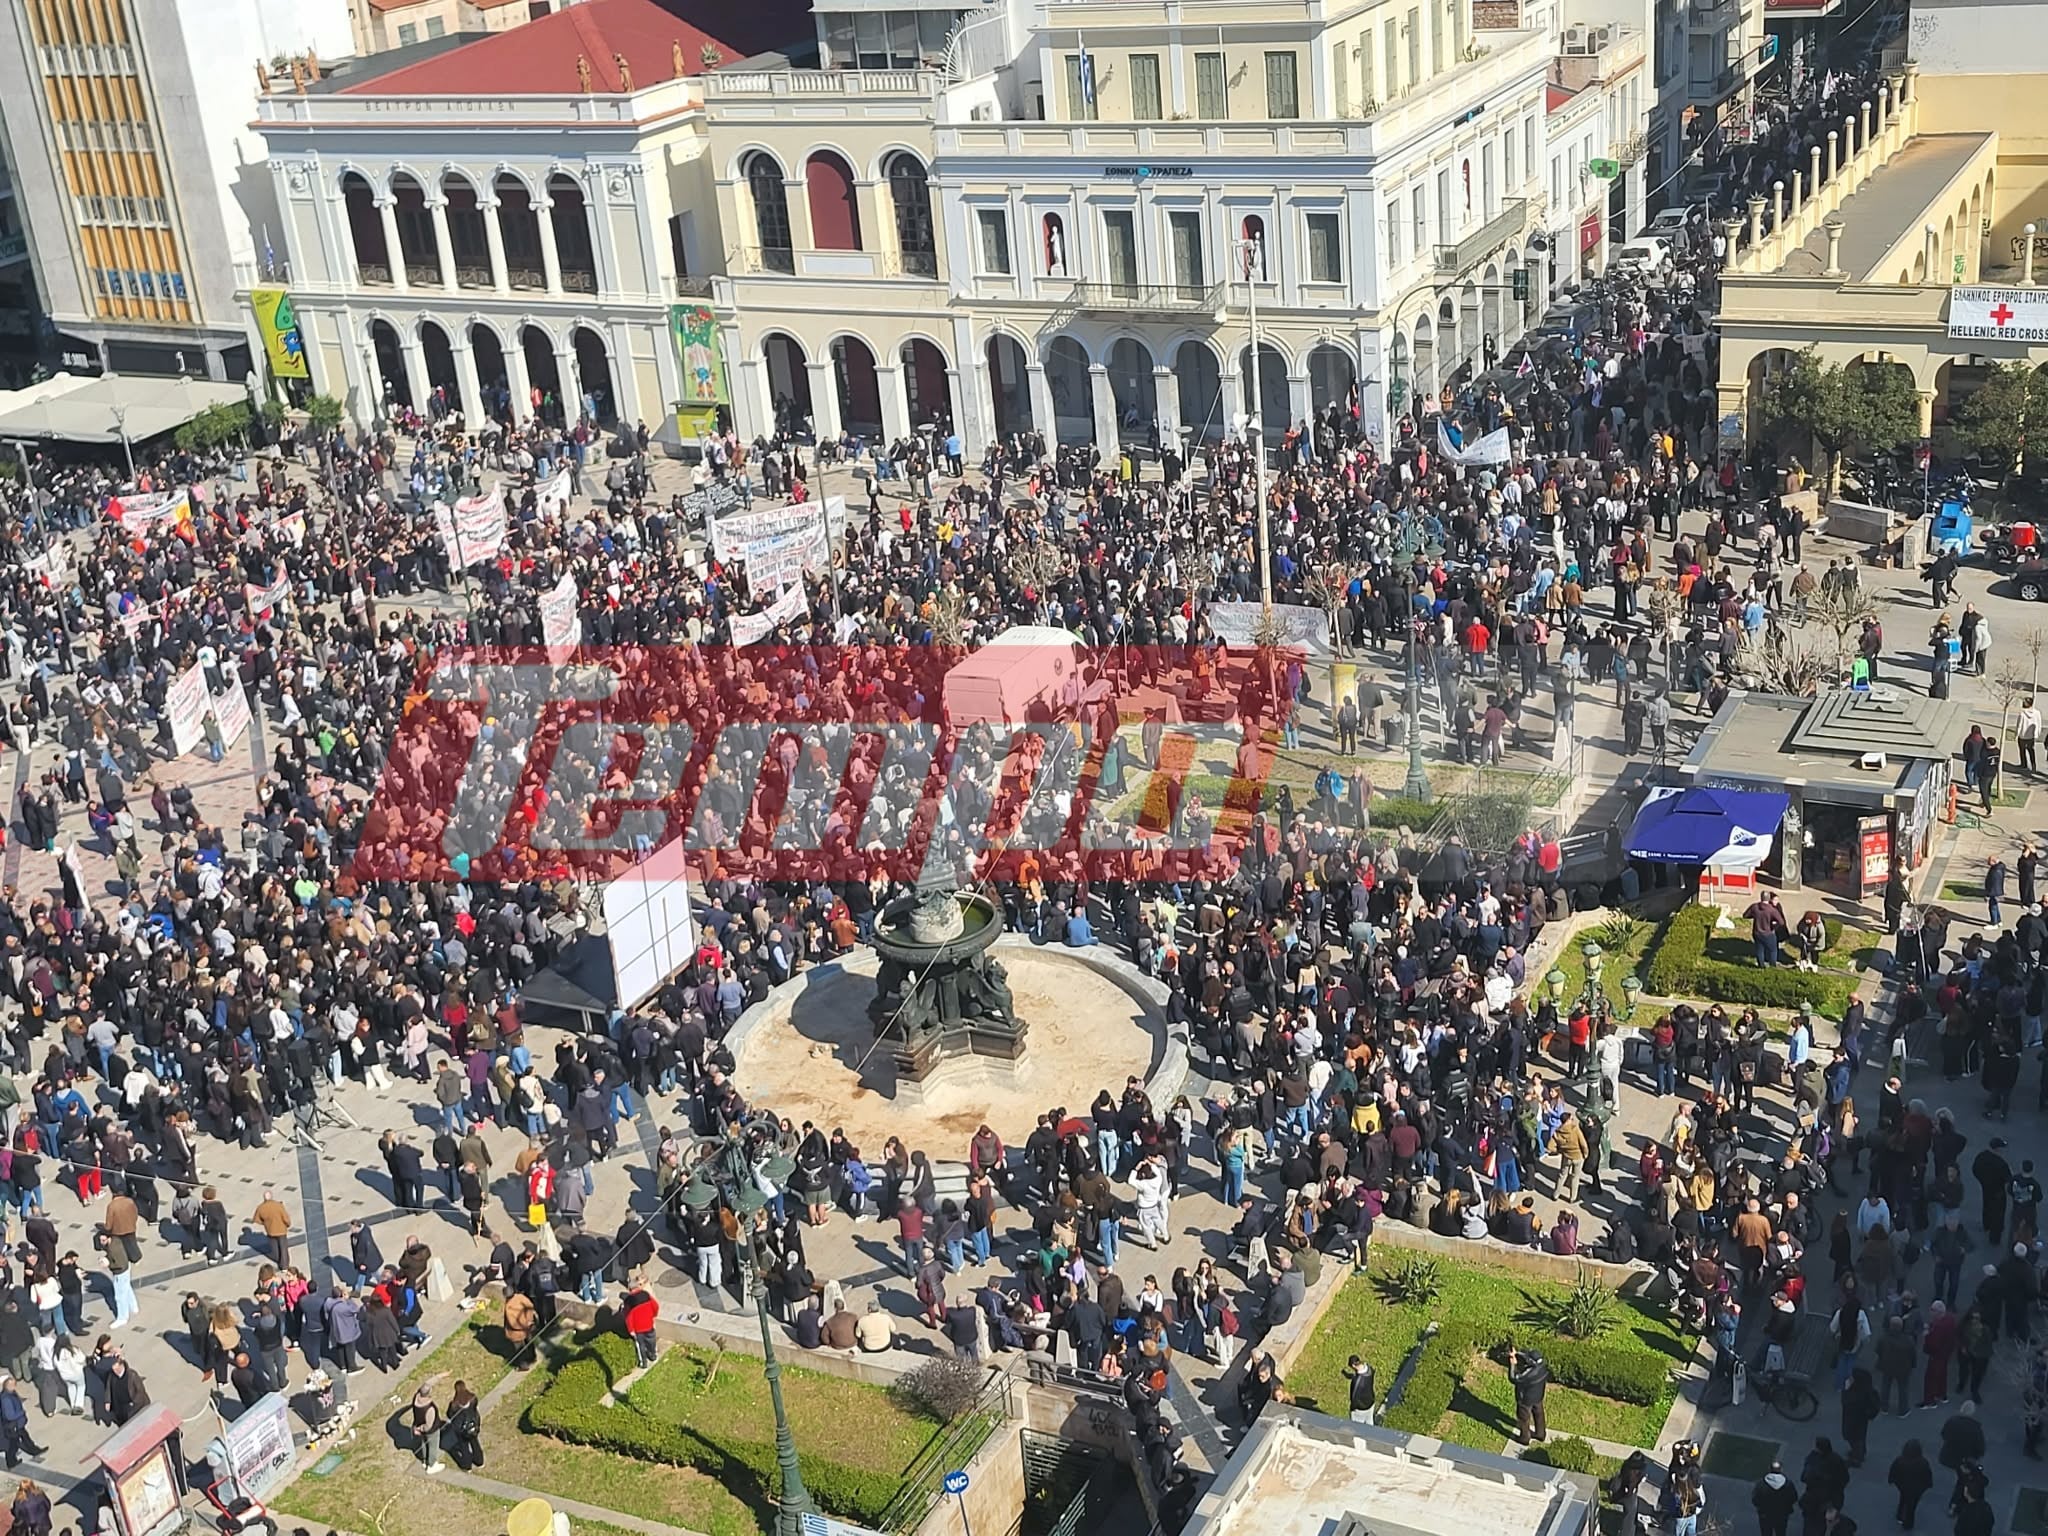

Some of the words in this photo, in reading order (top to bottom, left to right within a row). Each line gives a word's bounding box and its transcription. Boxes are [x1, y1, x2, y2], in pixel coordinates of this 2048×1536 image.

[1105, 167, 1138, 176] ΕΘΝΙΚΗ
[1151, 167, 1193, 176] ΤΡΑΠΕΖΑ
[1954, 289, 1991, 302] ΕΛΛΗΝΙΚΟΣ
[1993, 290, 2023, 303] ΕΡΥΘΡΟΣ
[1951, 325, 1996, 338] HELLENIC
[1998, 327, 2017, 338] RED
[946, 1475, 967, 1491] WC
